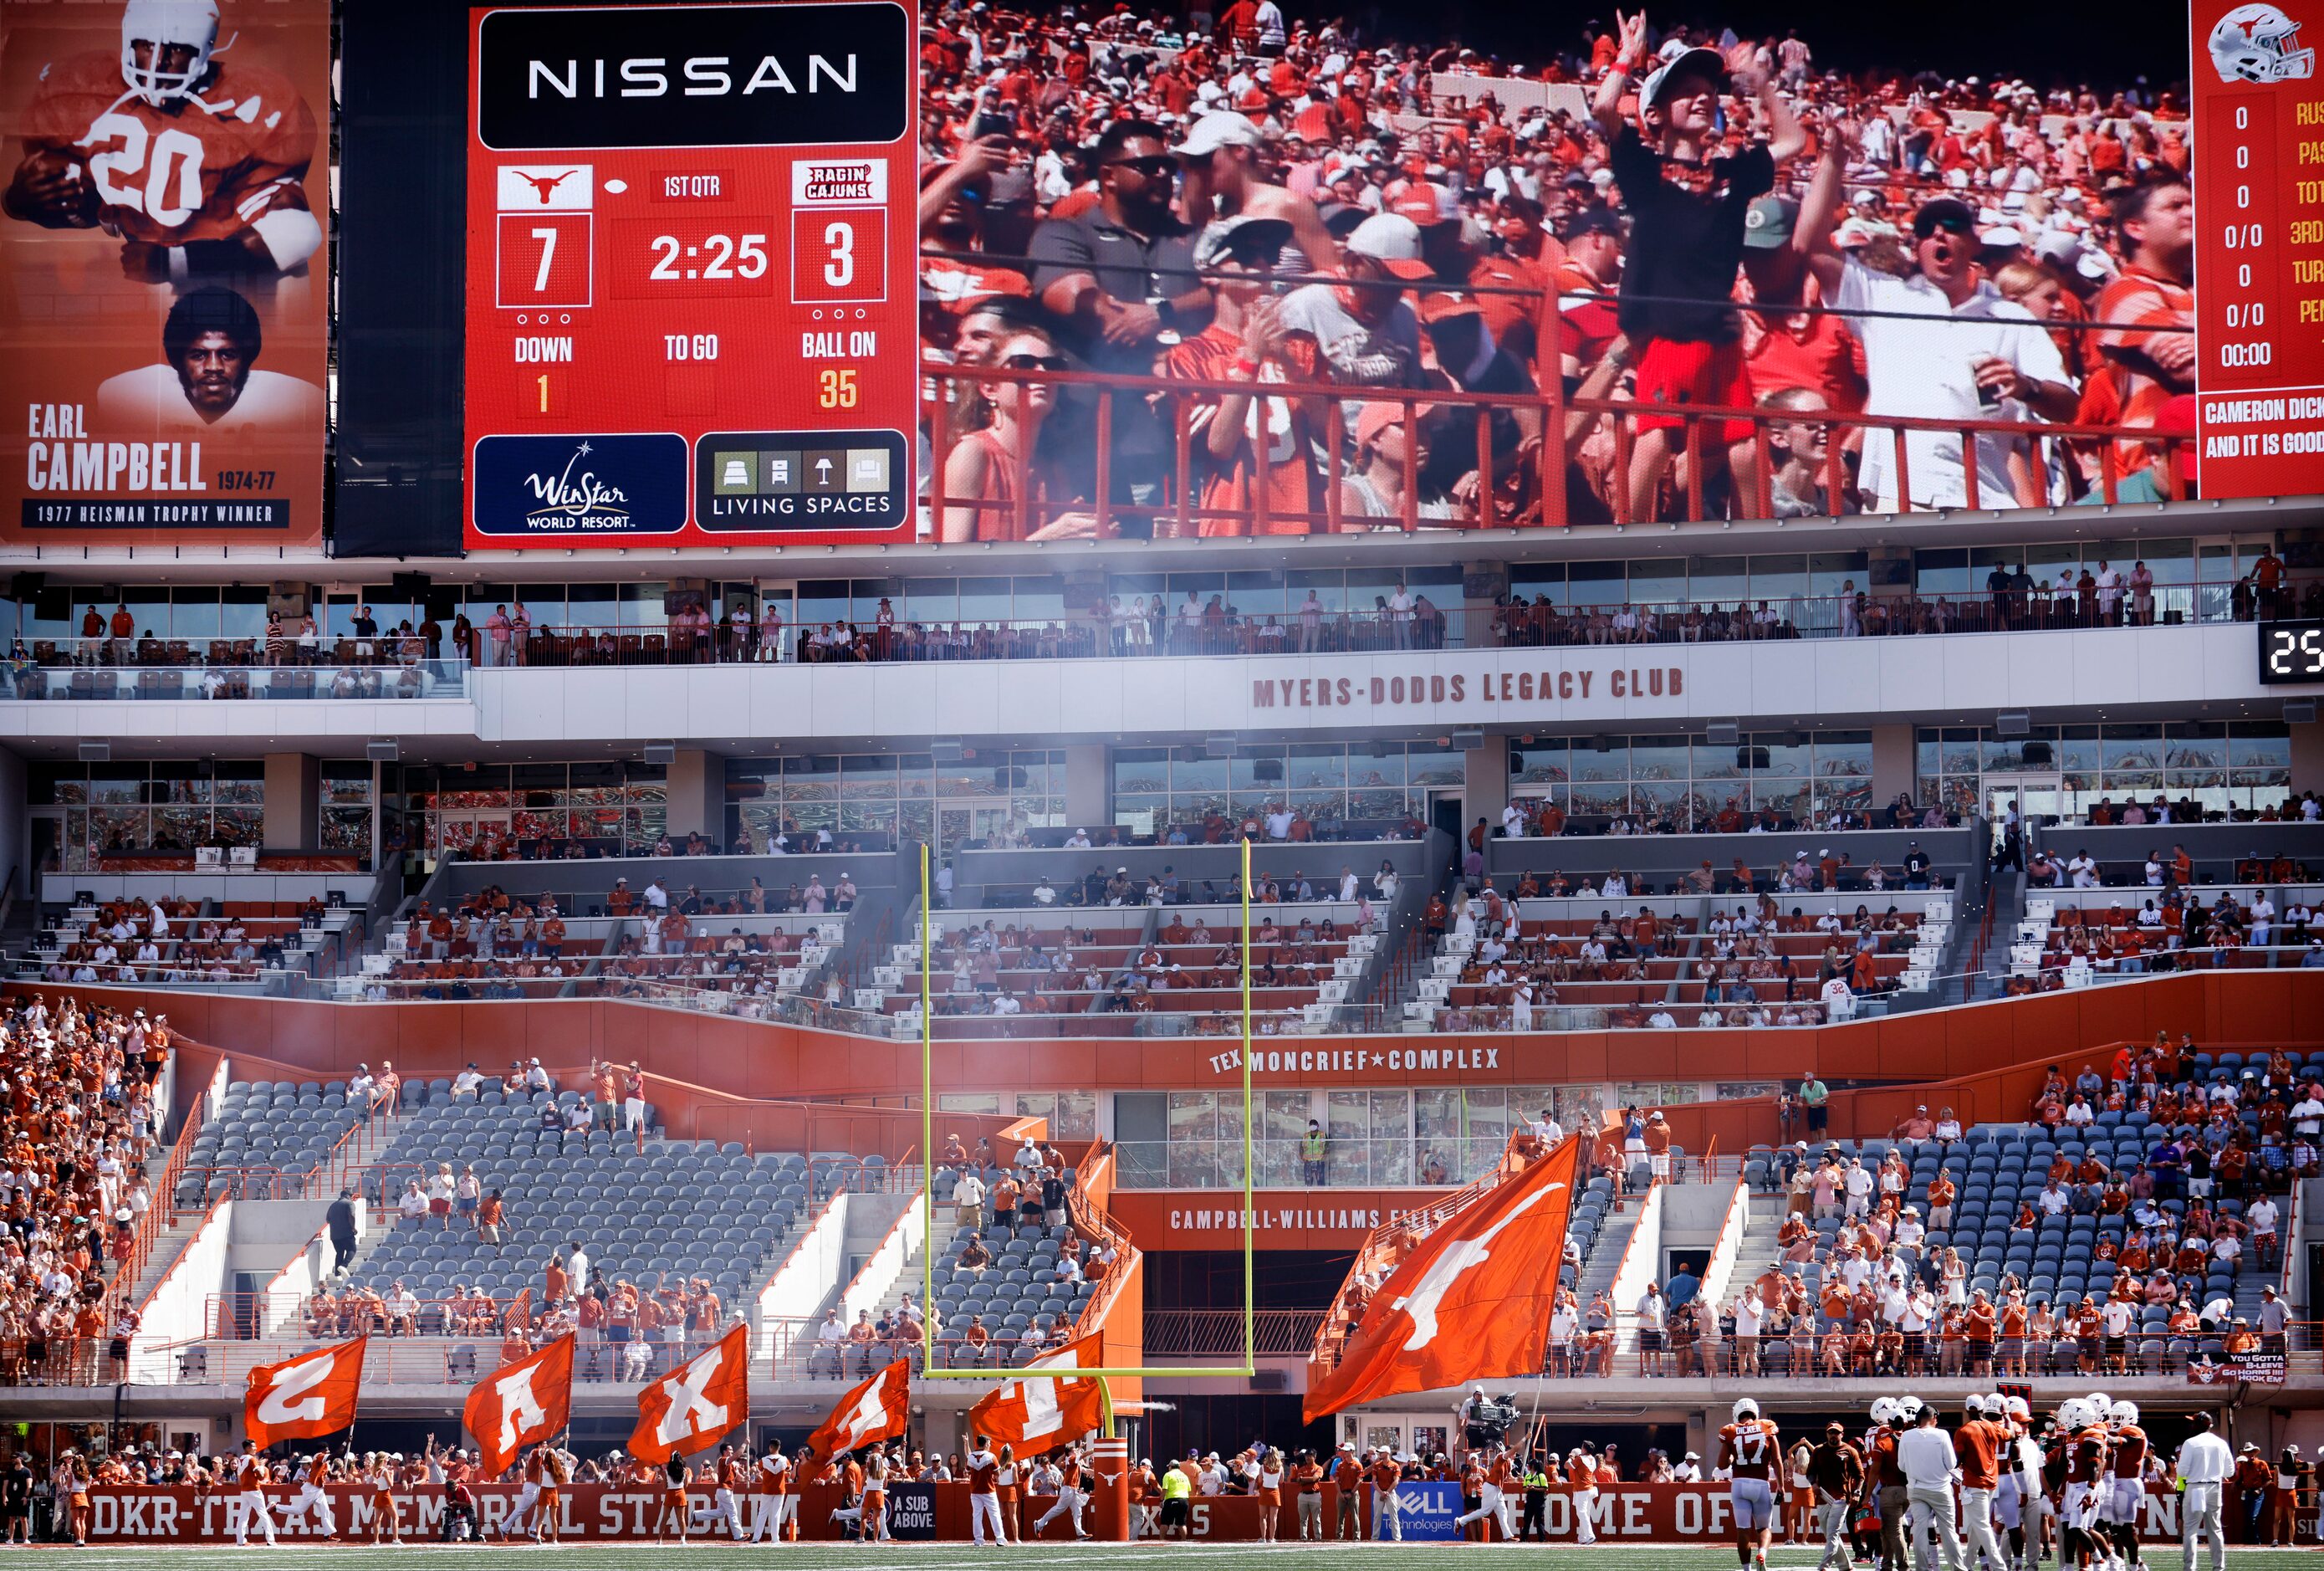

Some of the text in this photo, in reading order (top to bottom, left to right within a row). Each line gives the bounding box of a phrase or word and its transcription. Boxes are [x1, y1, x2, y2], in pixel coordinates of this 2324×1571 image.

[529, 54, 857, 99] NISSAN
[2235, 106, 2248, 130] 0
[89, 113, 206, 227] 20
[2236, 146, 2249, 169] 0
[664, 175, 720, 197] 1ST QTR
[807, 183, 867, 198] CAJUNS
[2237, 185, 2250, 208] 0
[2224, 223, 2263, 249] 0/0
[2290, 220, 2324, 245] 3RD
[530, 228, 558, 292] 7
[650, 233, 768, 280] 2:25
[824, 222, 854, 288] 3
[2239, 264, 2251, 287] 0
[2226, 302, 2264, 329] 0/0
[514, 336, 573, 363] DOWN
[664, 335, 718, 361] TO GO
[802, 332, 876, 358] BALL ON
[2220, 341, 2271, 367] 00:00
[537, 374, 549, 413] 1
[820, 369, 857, 409] 35
[28, 403, 88, 439] EARL
[2205, 397, 2286, 424] CAMERON
[2205, 435, 2240, 458] AND
[2242, 433, 2259, 457] IT
[2262, 432, 2280, 456] IS
[27, 441, 275, 491] CAMPBELL 1974-77
[524, 453, 628, 516] WinStar
[38, 505, 273, 523] 1977 HEISMAN TROPHY WINNER
[713, 496, 891, 516] LIVING SPACES
[526, 516, 576, 530] WORLD
[581, 515, 630, 529] RESORT
[2270, 629, 2324, 674] 25
[1254, 668, 1683, 708] MYERS-DODDS LEGACY CLUB
[1911, 860, 1918, 872] 0
[1830, 982, 1845, 995] 32
[1209, 1048, 1499, 1074] TEX MONCRIEF COMPLEX
[1170, 1209, 1380, 1230] CAMPBELL-WILLIAMS
[116, 1321, 133, 1337] 25
[1735, 1424, 1762, 1435] DICKER
[1733, 1432, 1767, 1466] 17
[349, 1493, 585, 1535] MEMRIL
[894, 1495, 929, 1512] A SUB
[1675, 1492, 1732, 1534] OF
[893, 1512, 936, 1528] ABOVE.
[1382, 1517, 1453, 1533] Tehnologies
